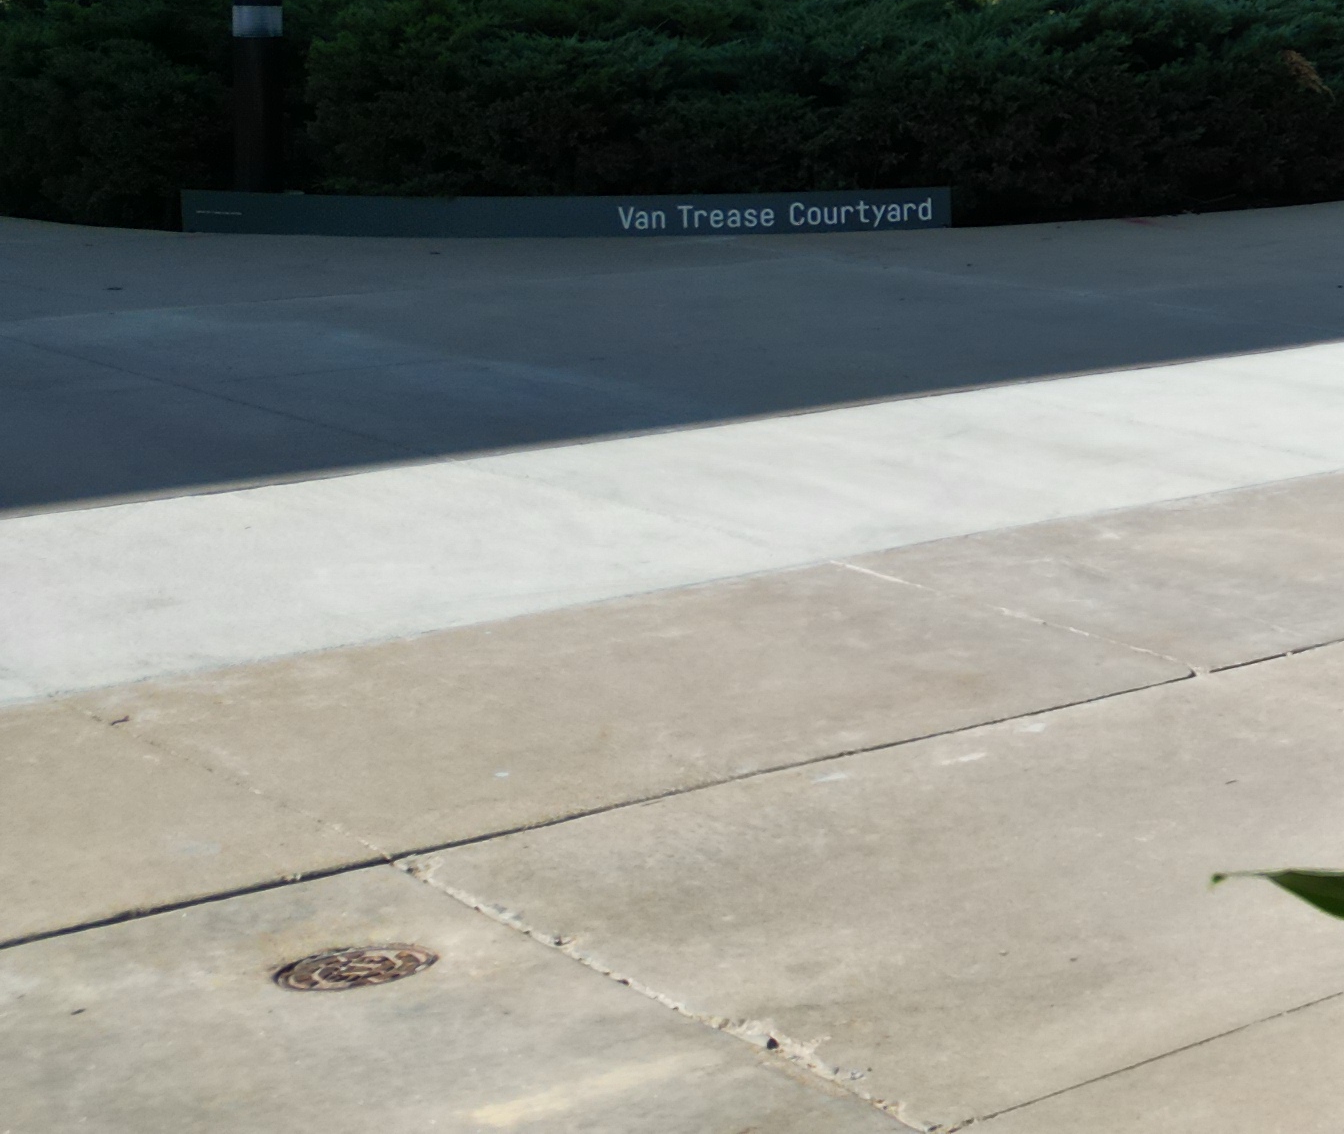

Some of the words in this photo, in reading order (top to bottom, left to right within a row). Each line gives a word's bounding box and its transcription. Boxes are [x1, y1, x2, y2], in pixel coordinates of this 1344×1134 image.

[617, 206, 666, 230] Van
[677, 205, 775, 229] Trease
[788, 197, 933, 229] Courtyard
